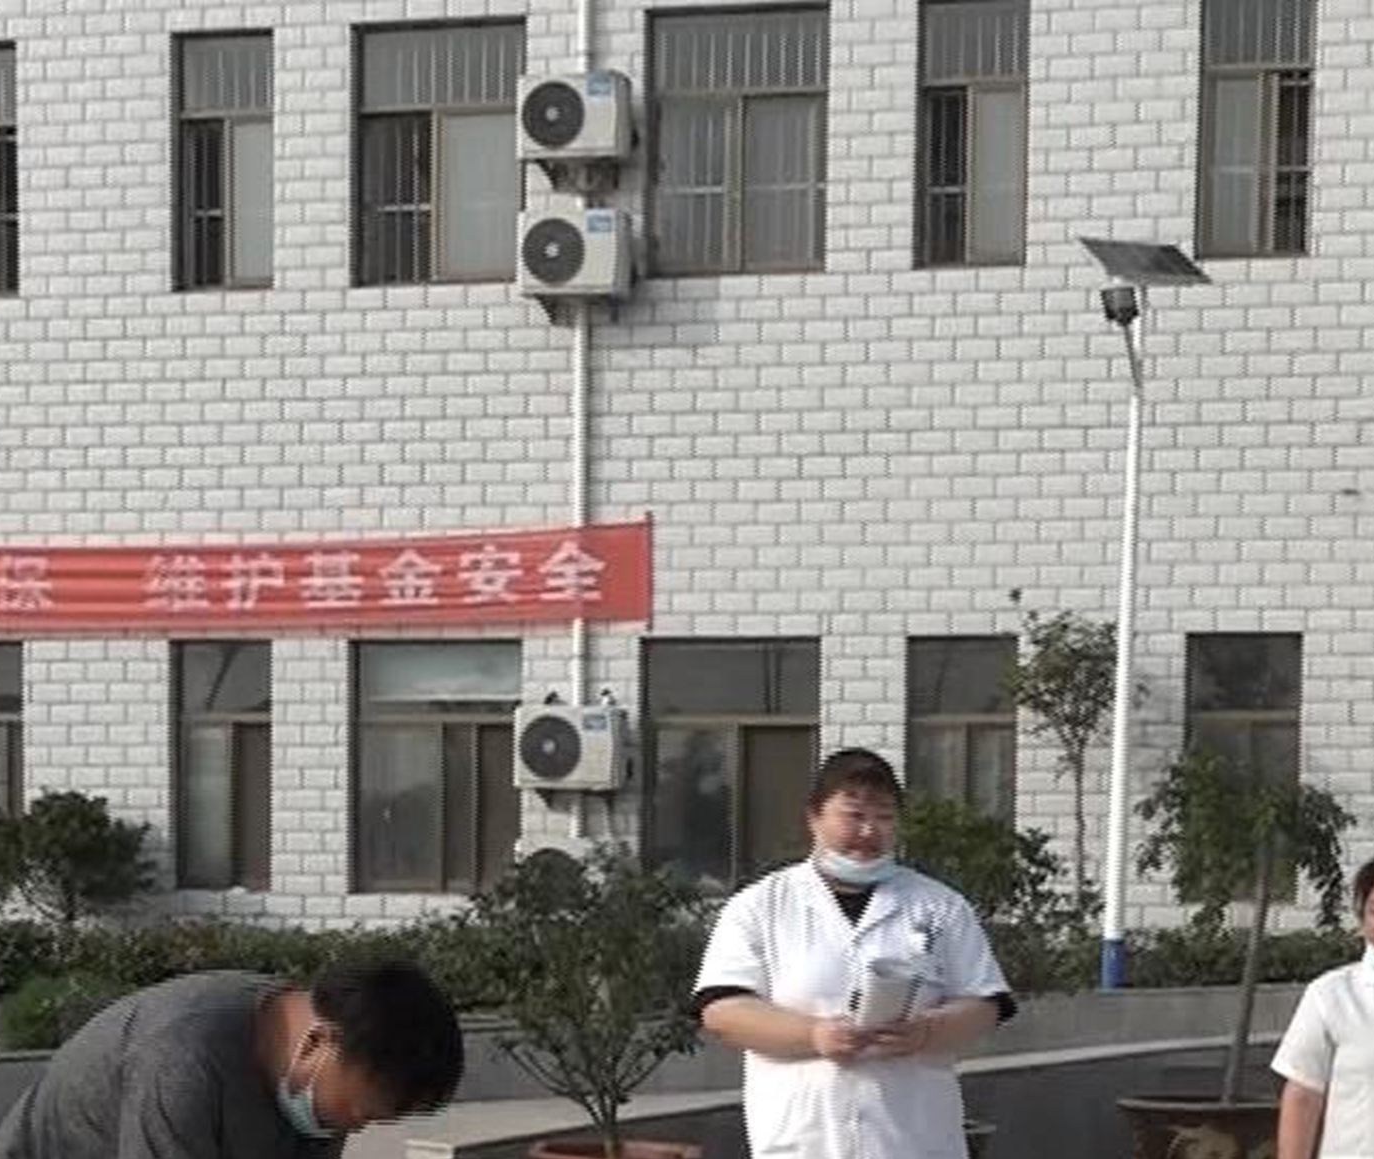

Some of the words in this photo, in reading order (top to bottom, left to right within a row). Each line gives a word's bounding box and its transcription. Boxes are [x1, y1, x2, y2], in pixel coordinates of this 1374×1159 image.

[144, 540, 608, 610] 维护基金安全
